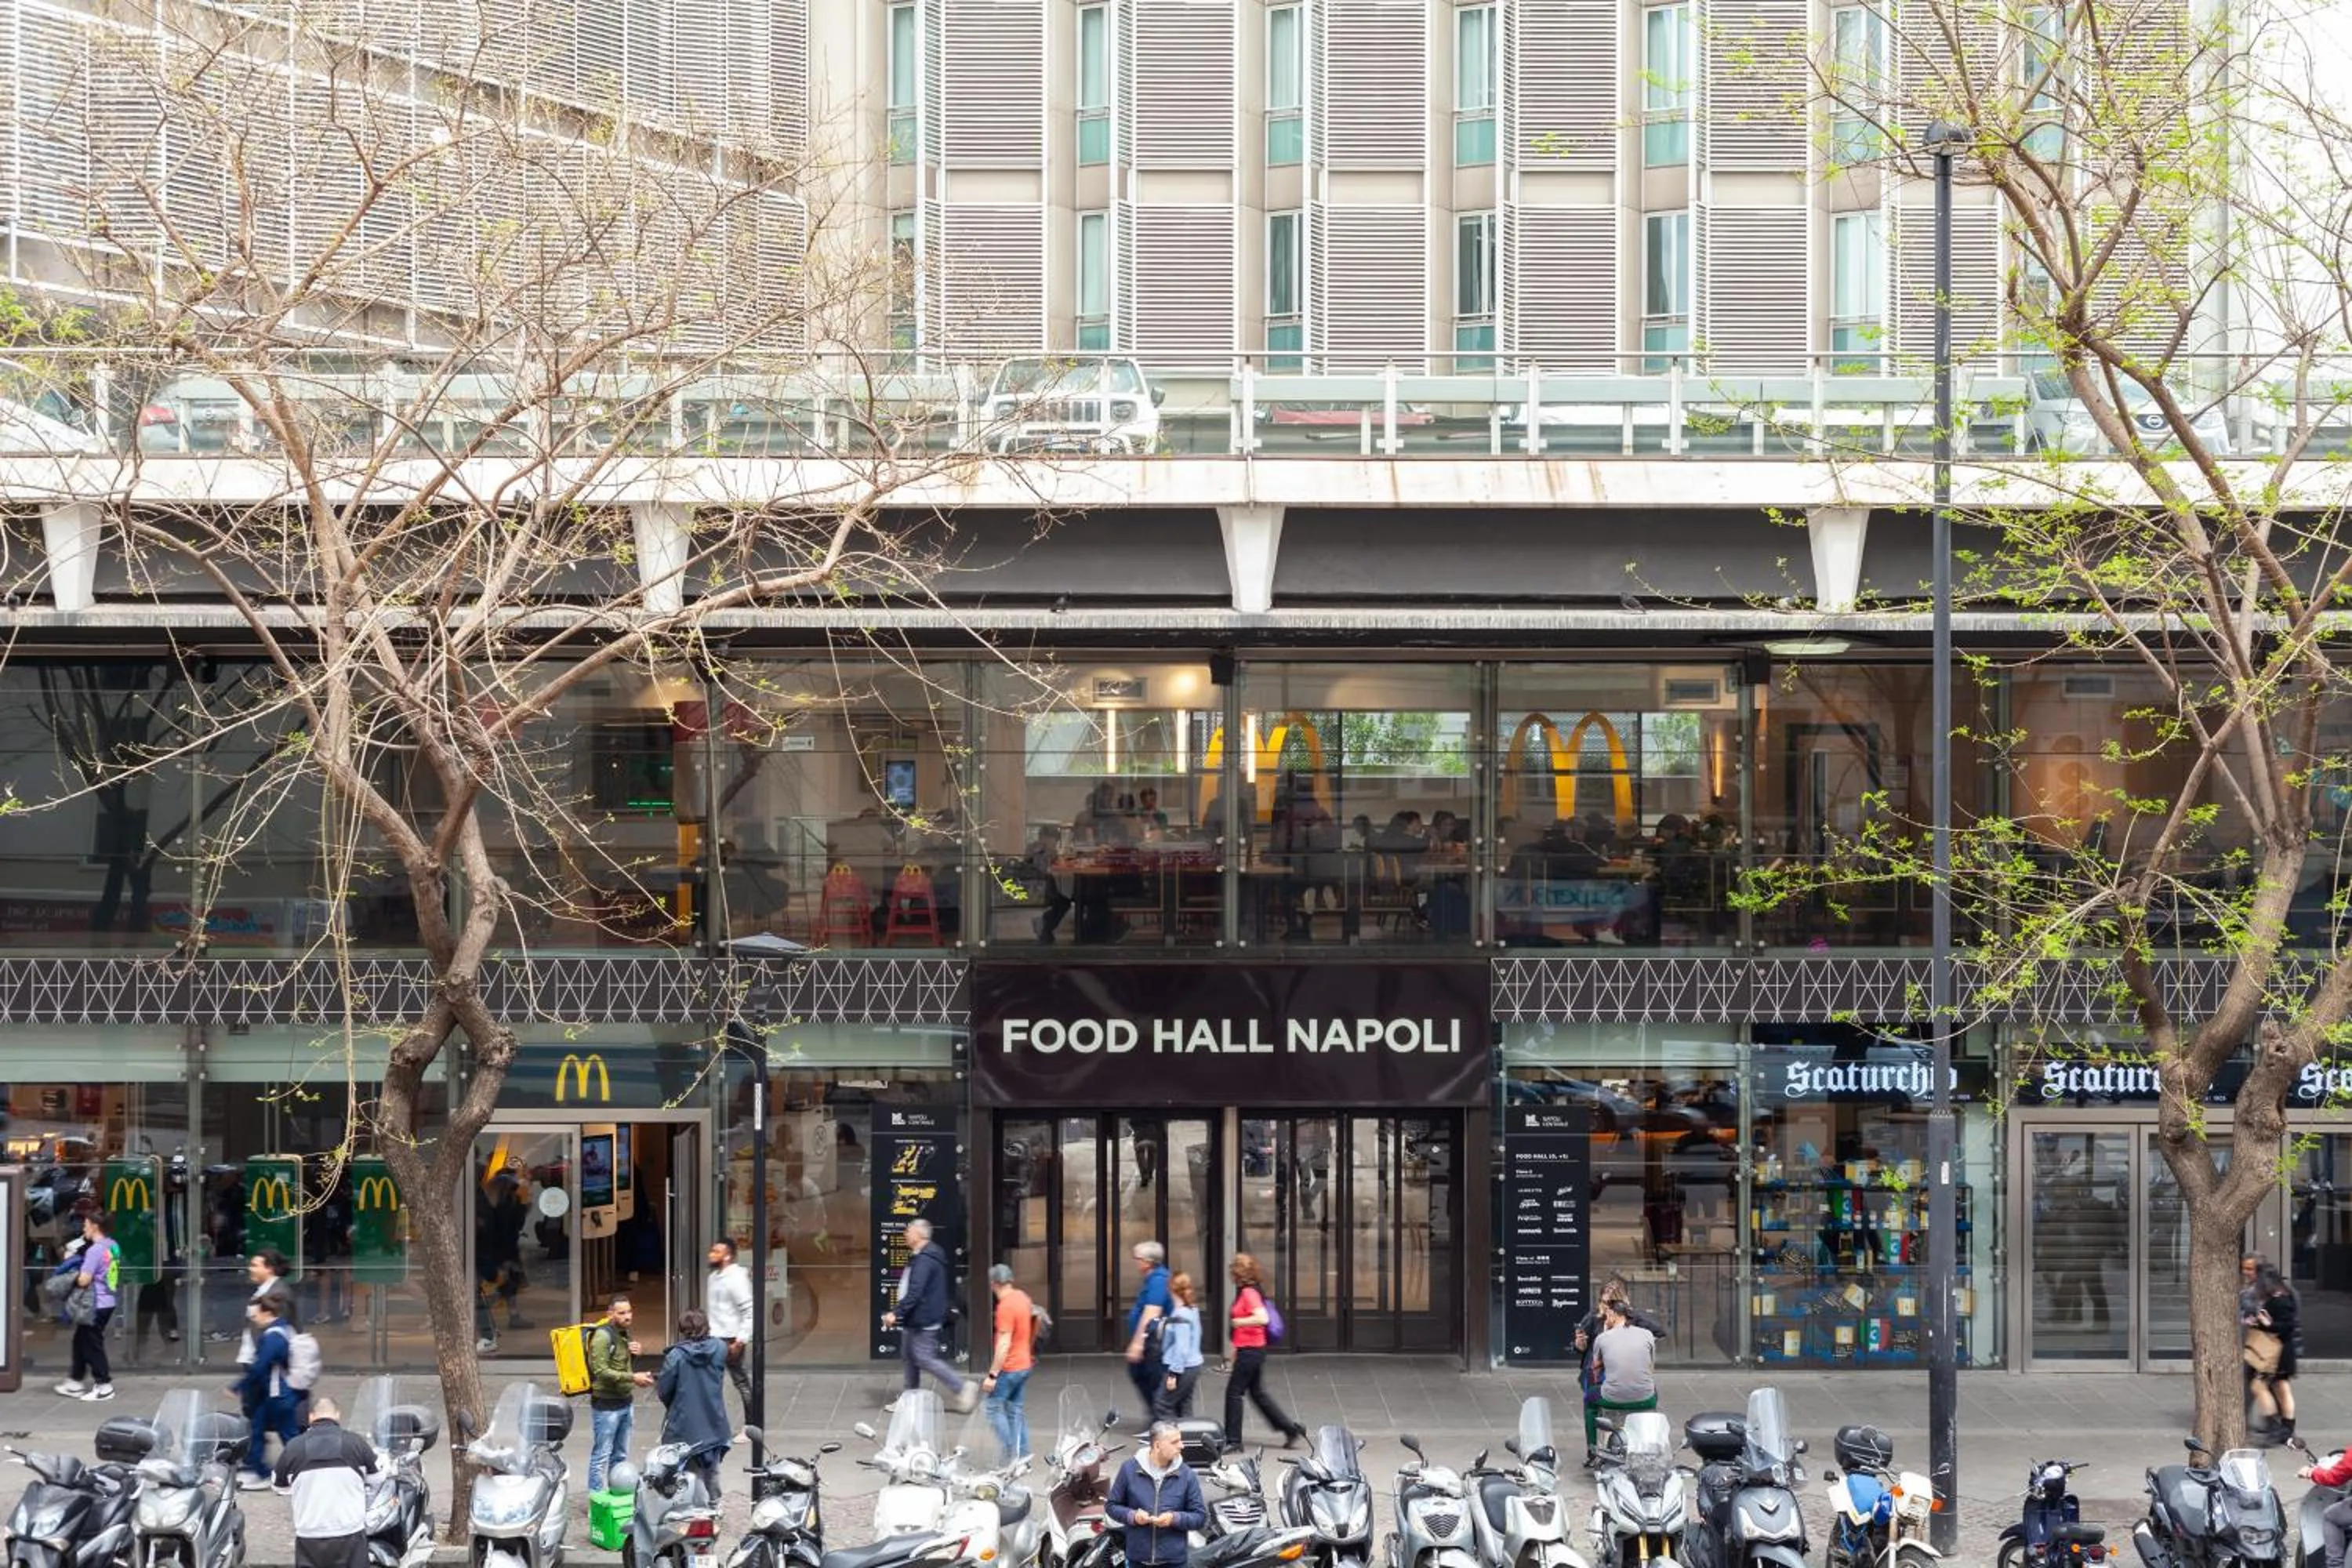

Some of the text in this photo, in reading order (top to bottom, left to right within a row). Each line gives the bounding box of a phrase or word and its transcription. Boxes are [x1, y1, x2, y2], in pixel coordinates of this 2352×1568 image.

[1003, 1018, 1461, 1053] FOOD HALL NAPOLI
[2041, 1060, 2213, 1098] Scatur
